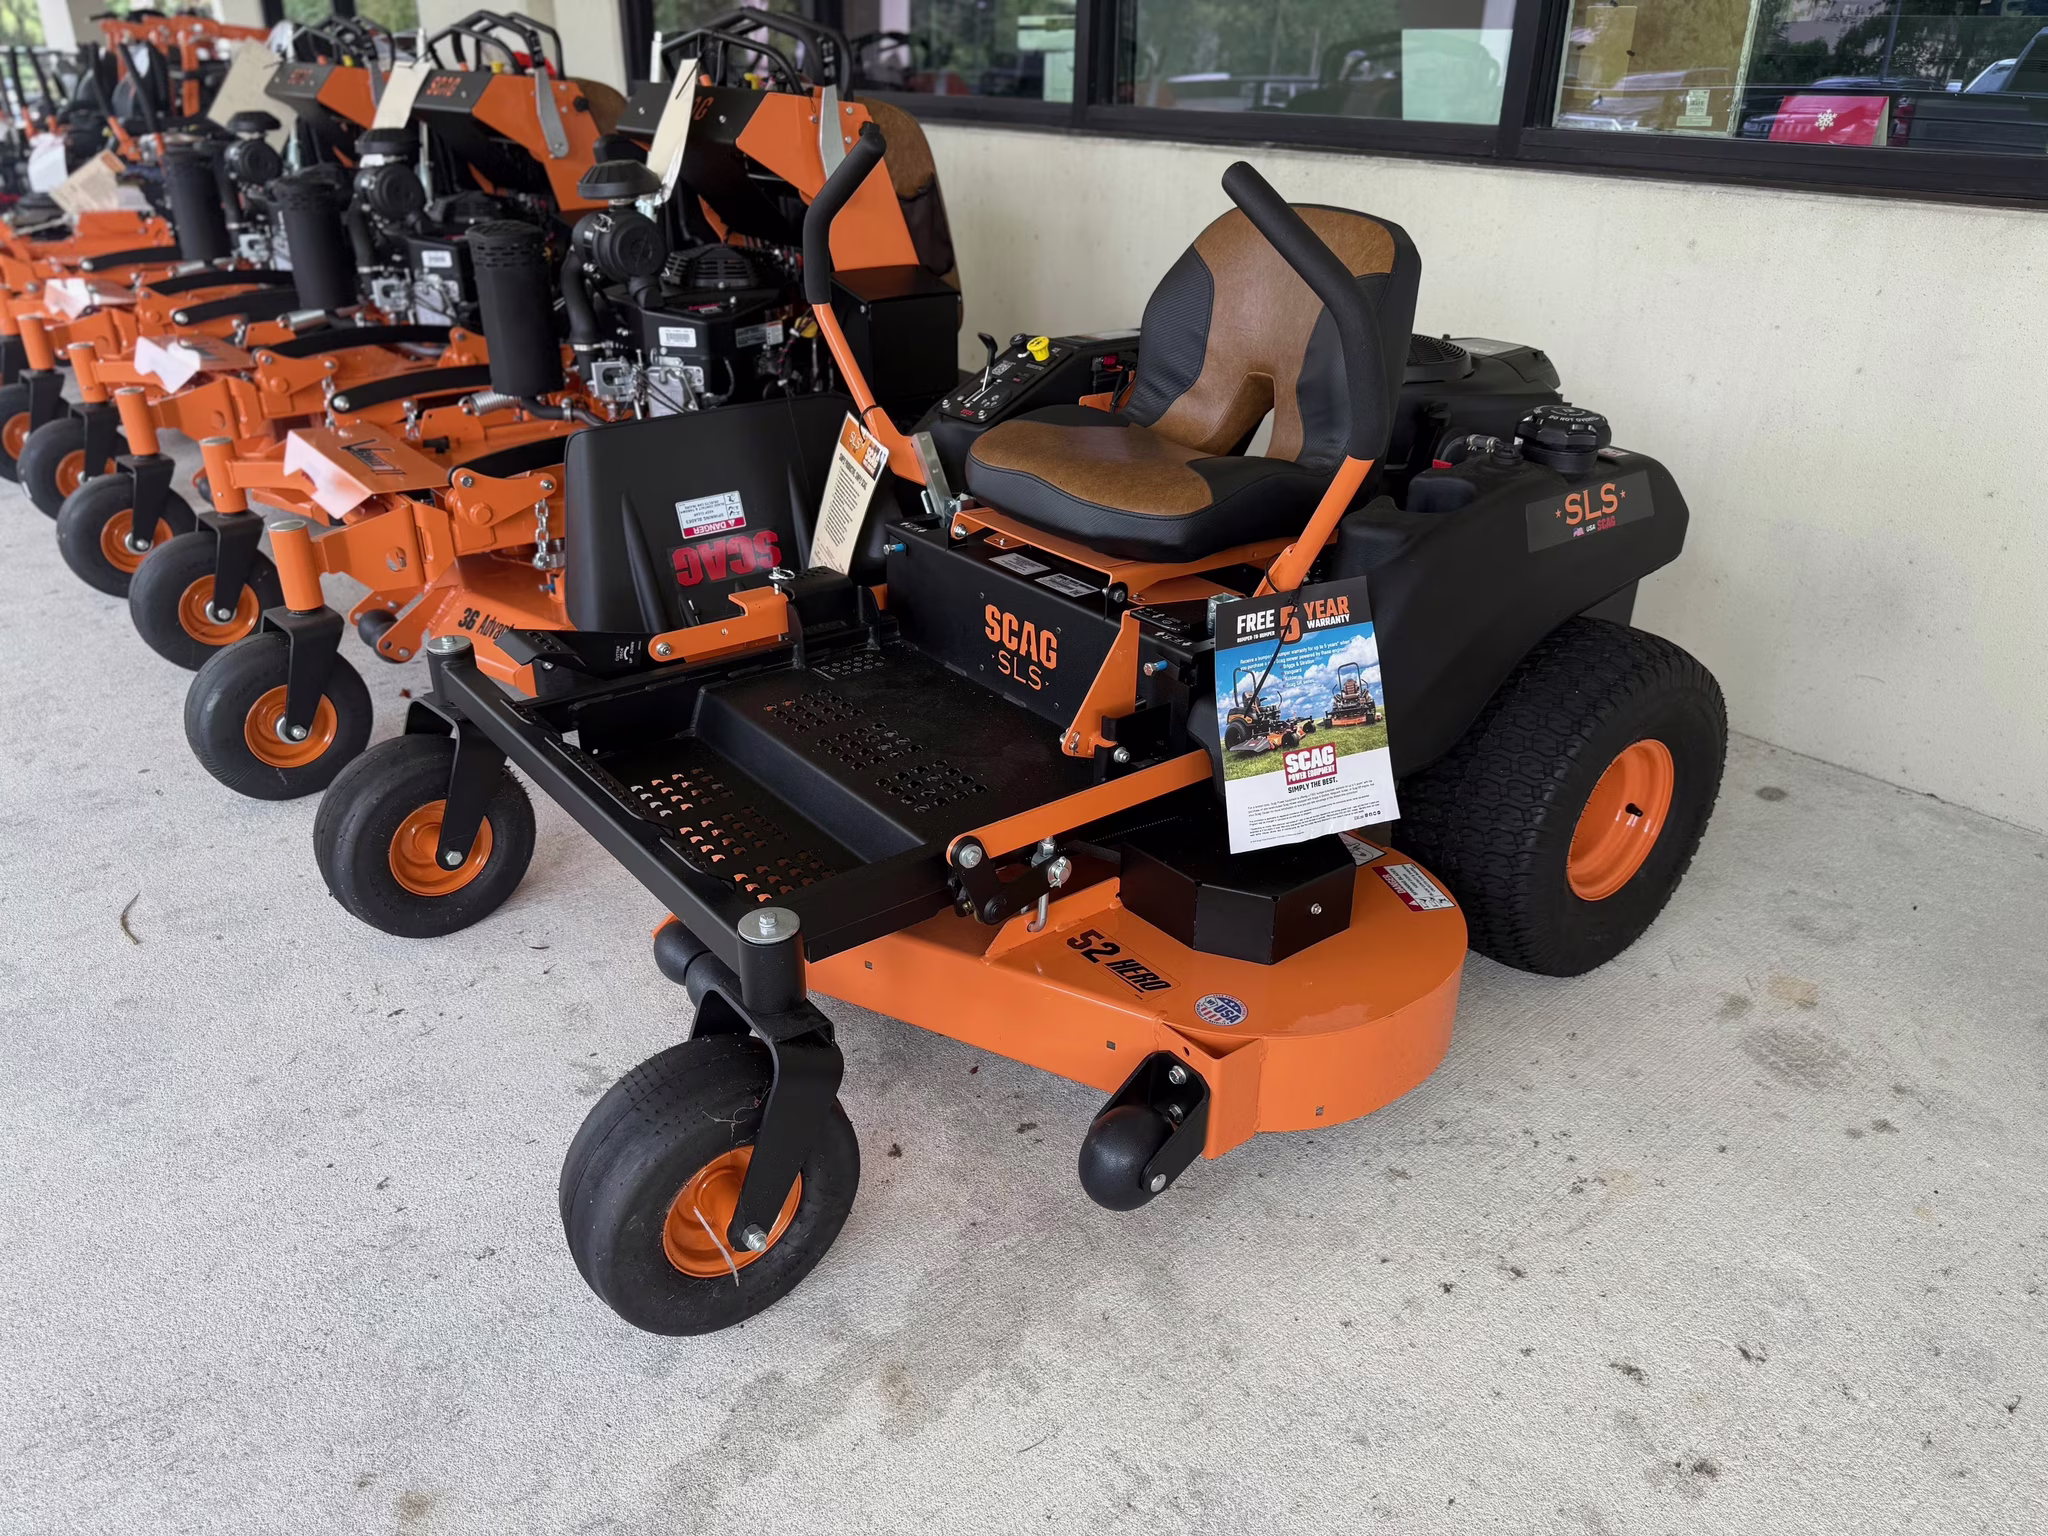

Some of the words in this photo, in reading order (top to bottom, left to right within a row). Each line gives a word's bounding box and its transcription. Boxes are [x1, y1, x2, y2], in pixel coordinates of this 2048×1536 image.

[1565, 482, 1618, 526] SLS
[692, 520, 727, 535] DANGER
[1597, 515, 1617, 532] SCAG
[672, 530, 782, 586] SCAG
[458, 606, 481, 631] 36
[1236, 609, 1275, 634] FREE
[1280, 605, 1300, 642] 5
[1304, 596, 1350, 620] YEAR
[1306, 614, 1350, 630] WARRANTY
[985, 604, 1058, 670] SCAG
[998, 650, 1042, 690] SLS
[1285, 746, 1334, 774] SCAG
[1288, 771, 1307, 782] POWER
[1307, 764, 1335, 778] EQUIPMENT
[1288, 783, 1310, 794] SIMPLY
[1310, 780, 1322, 788] THE
[1322, 776, 1338, 786] BEST.
[1066, 928, 1121, 964] 52
[1104, 958, 1172, 991] HERO
[1213, 1004, 1241, 1024] USA
